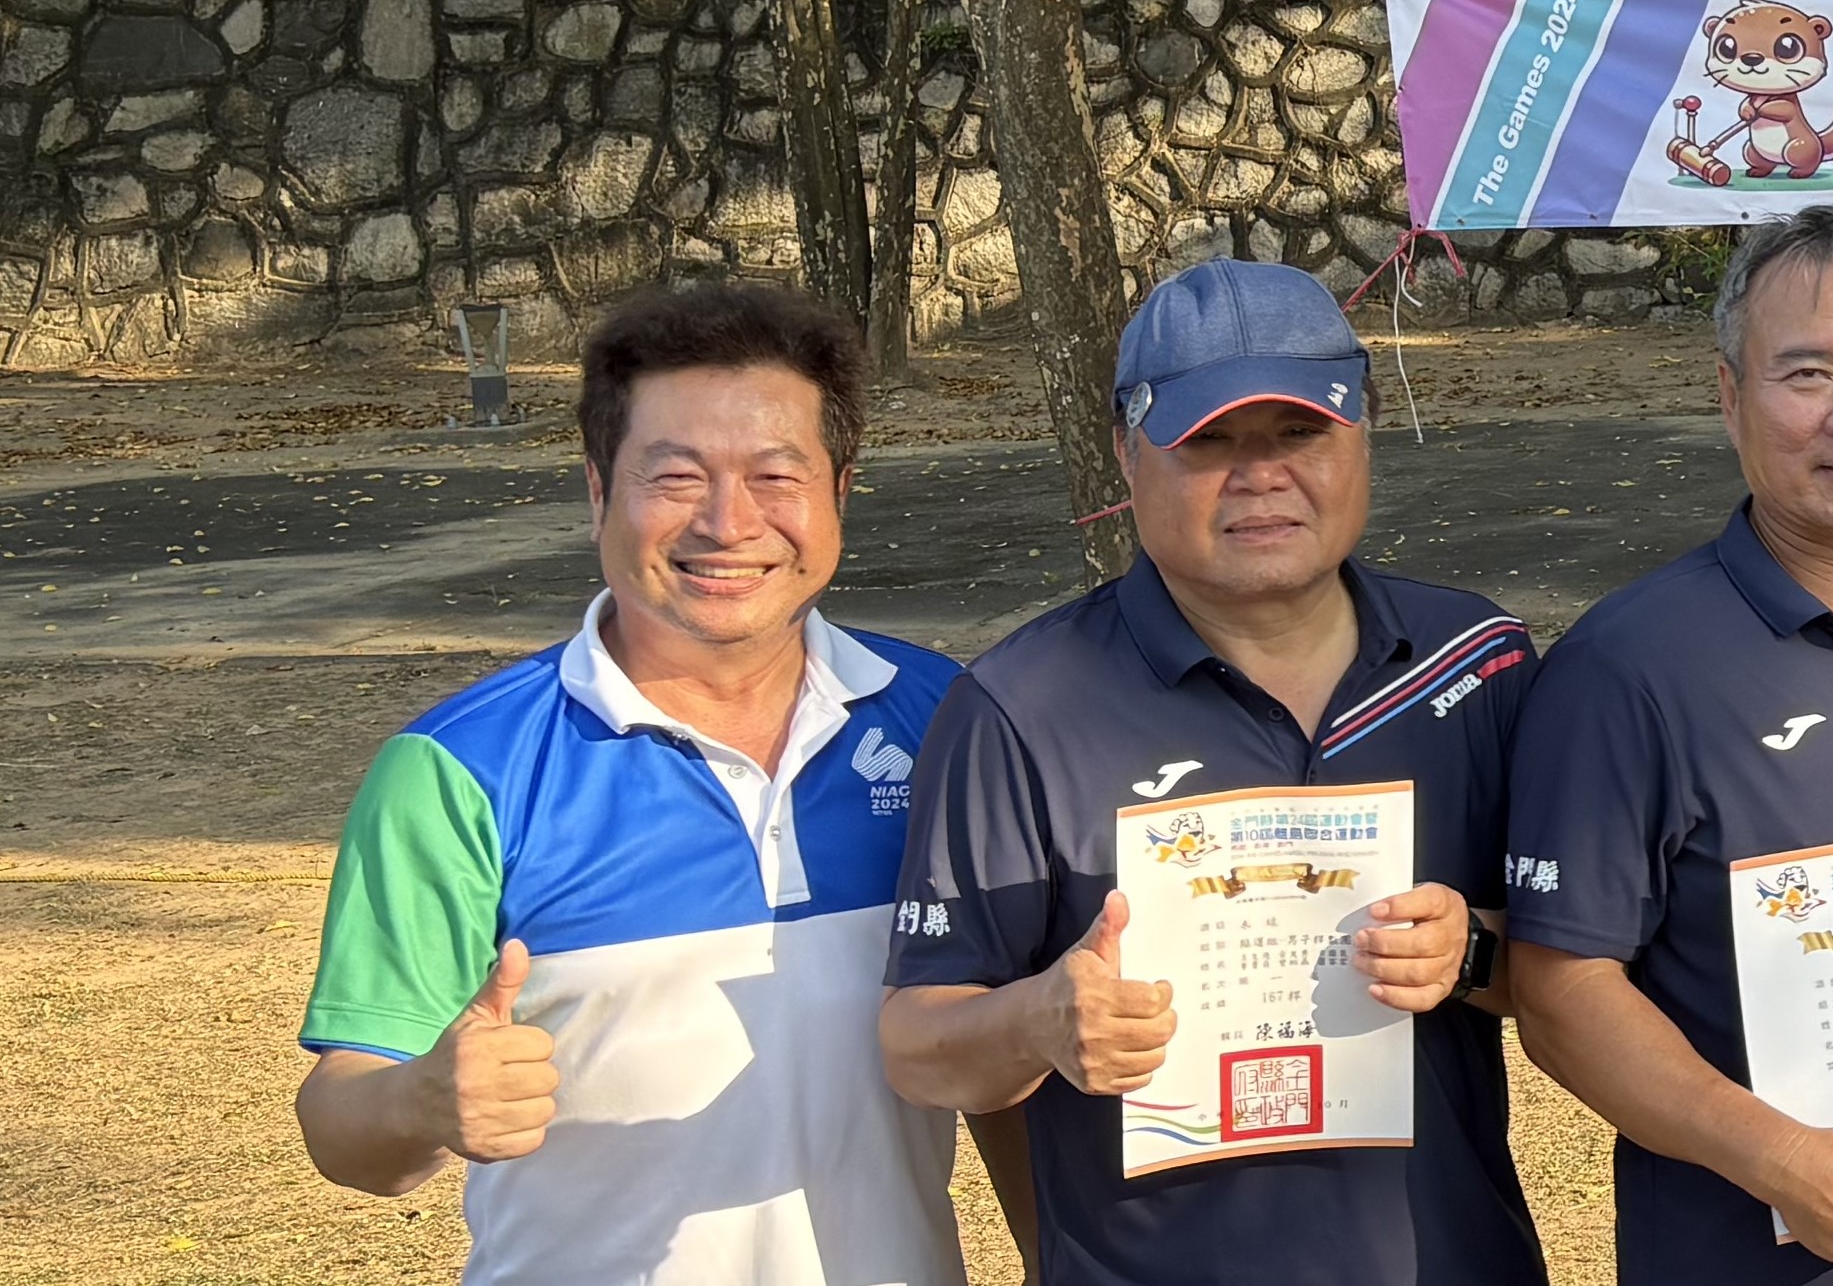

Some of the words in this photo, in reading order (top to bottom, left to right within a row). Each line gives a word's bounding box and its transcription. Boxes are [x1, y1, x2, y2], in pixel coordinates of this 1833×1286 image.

[1473, 155, 1509, 206] The
[1499, 54, 1551, 150] Games
[870, 785, 911, 798] NIAC
[870, 798, 910, 810] 2024
